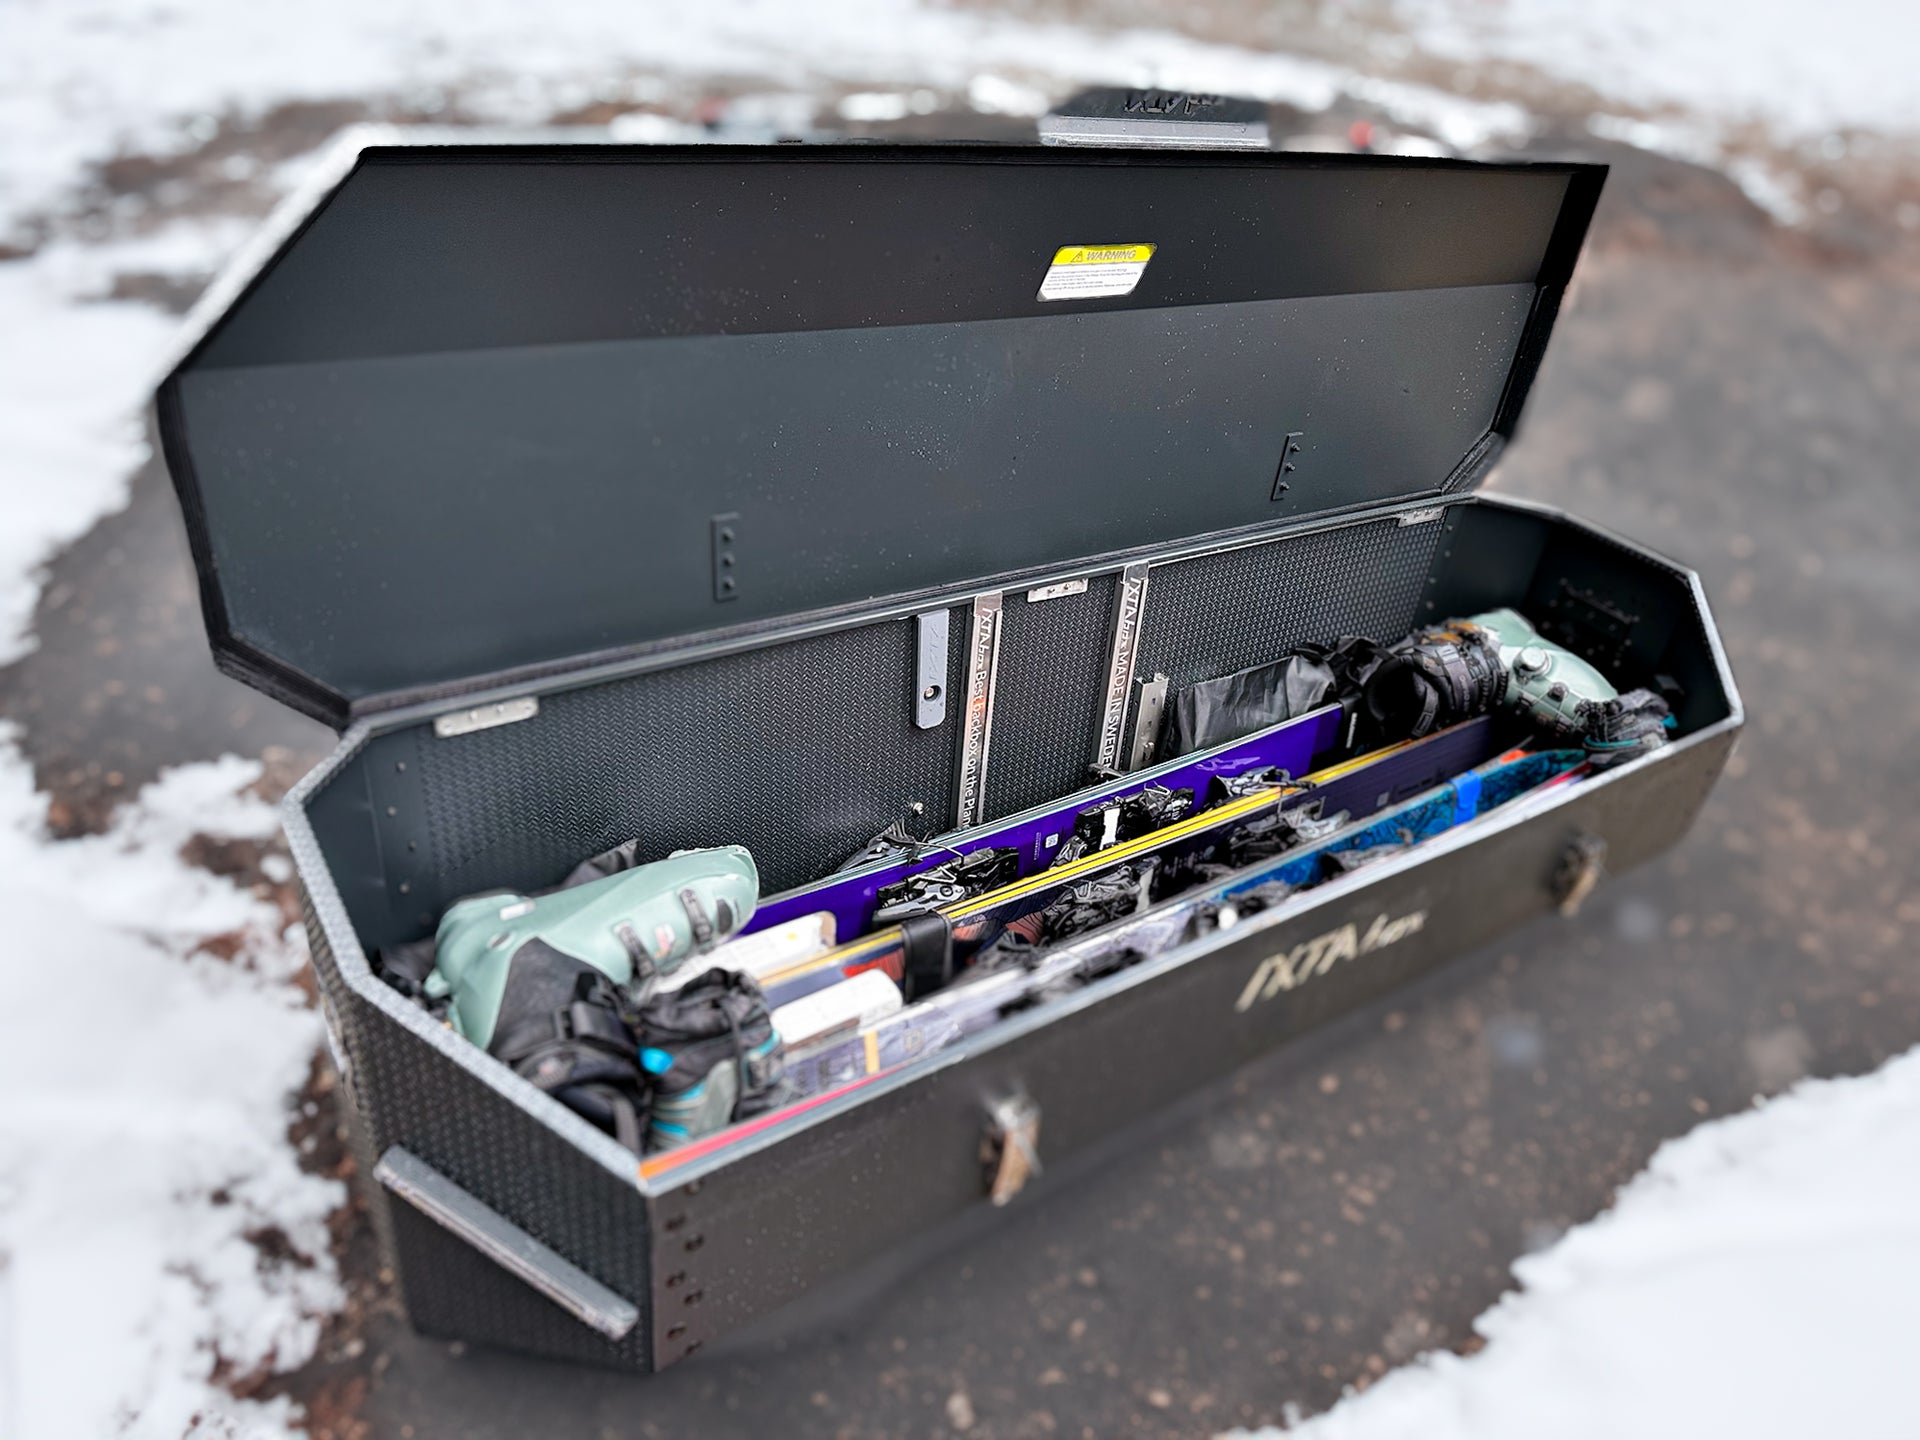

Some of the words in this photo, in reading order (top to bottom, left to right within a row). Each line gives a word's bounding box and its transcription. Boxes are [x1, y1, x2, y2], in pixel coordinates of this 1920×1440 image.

[1086, 249, 1136, 261] WARNING
[1112, 651, 1130, 695] MADE
[974, 670, 987, 702] Best
[1110, 697, 1122, 713] IN
[968, 702, 985, 757] backbox
[967, 758, 977, 774] on
[965, 775, 977, 797] the
